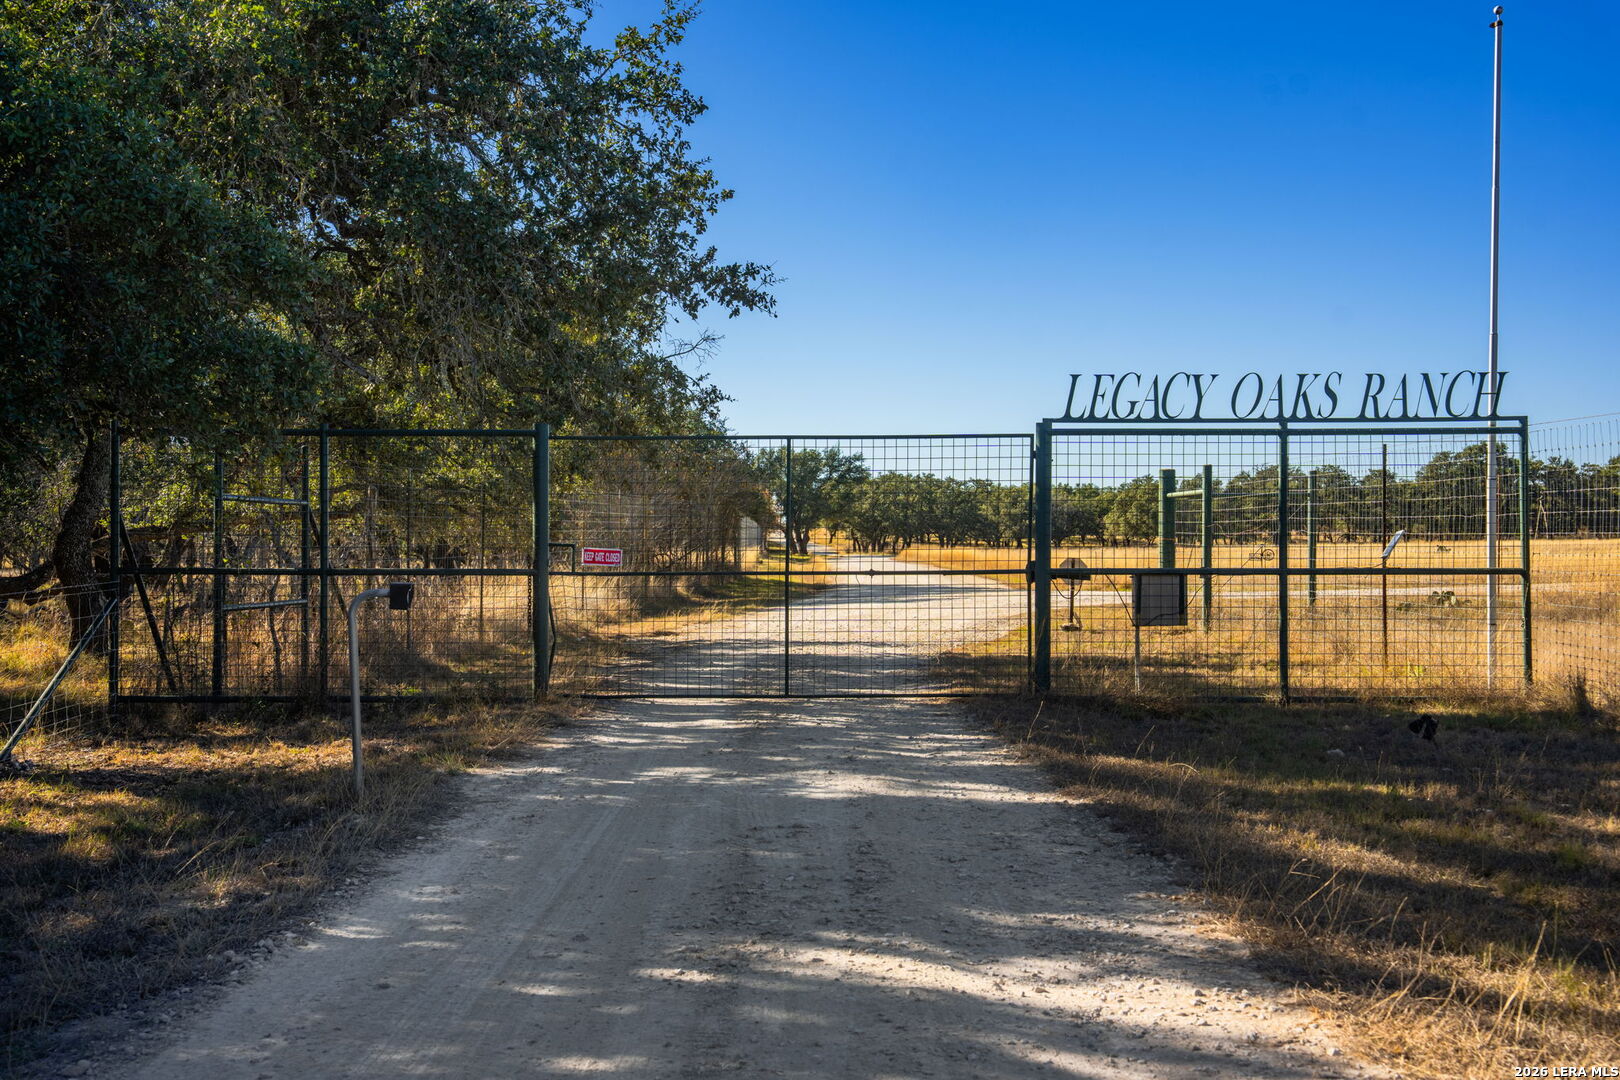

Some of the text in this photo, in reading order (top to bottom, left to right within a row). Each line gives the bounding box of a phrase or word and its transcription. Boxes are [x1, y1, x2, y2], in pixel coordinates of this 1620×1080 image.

[1063, 370, 1509, 419] LEGACY OAKS RANCH
[584, 552, 620, 562] KEEP GATE CLOSED
